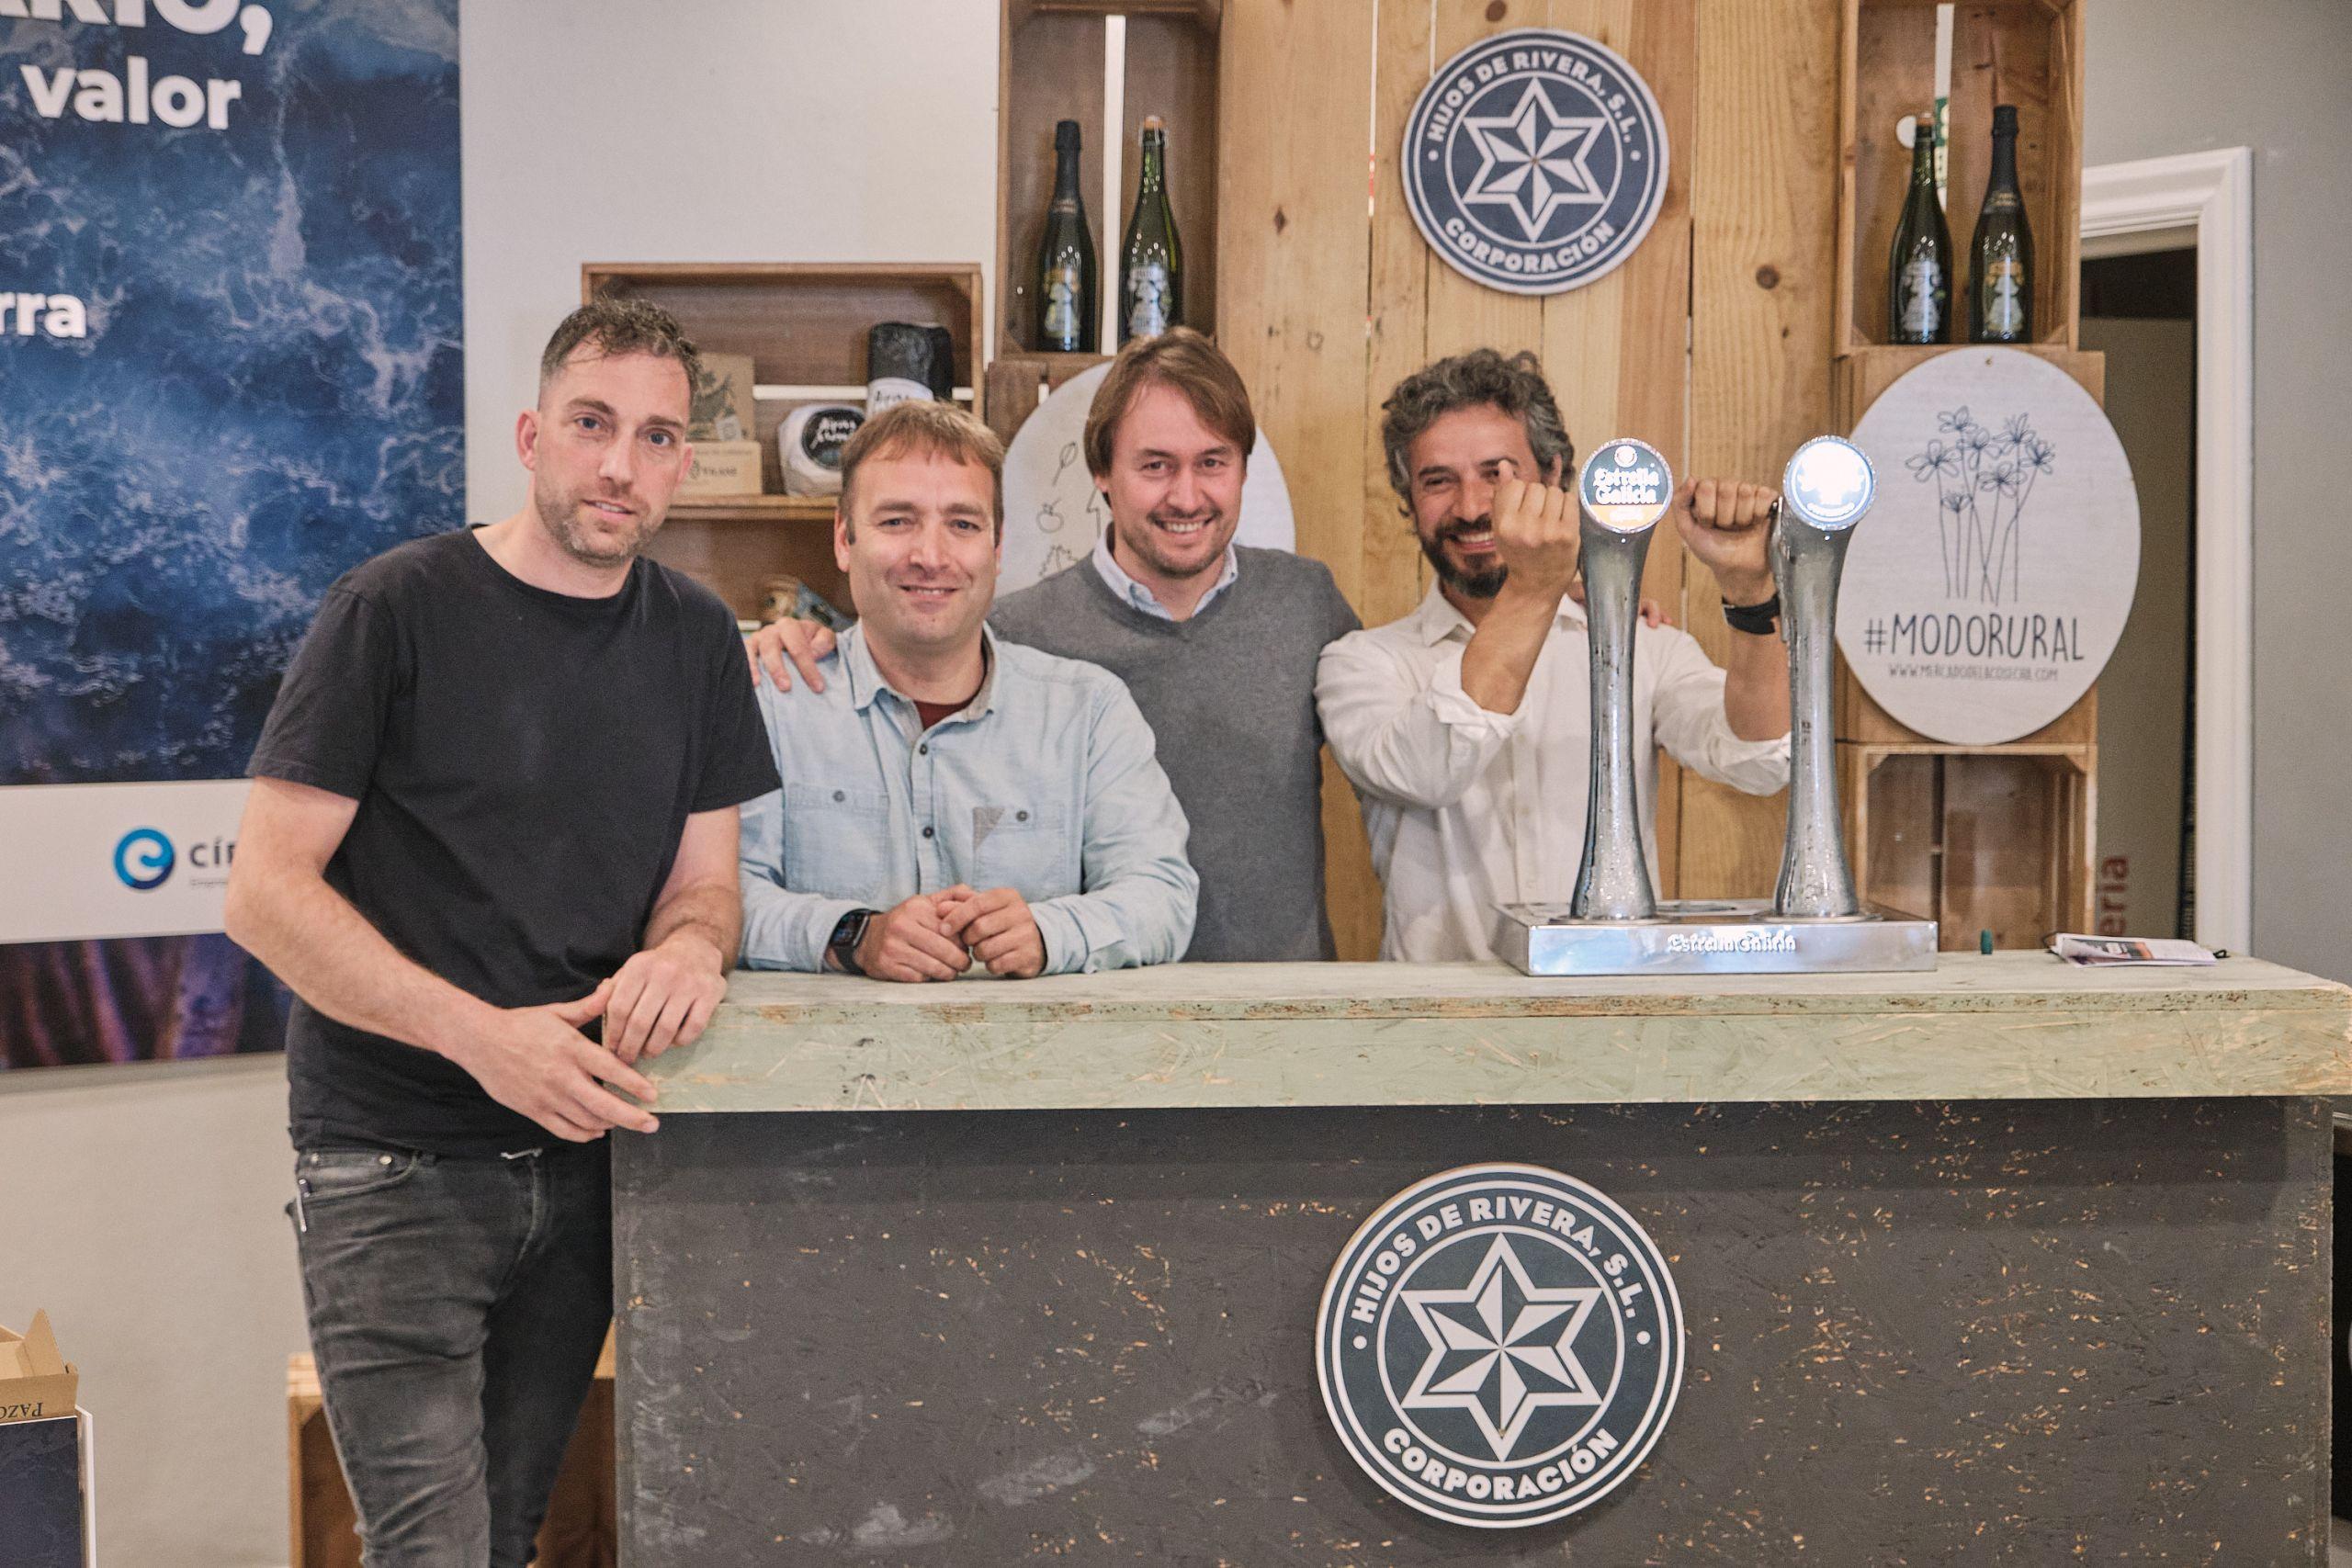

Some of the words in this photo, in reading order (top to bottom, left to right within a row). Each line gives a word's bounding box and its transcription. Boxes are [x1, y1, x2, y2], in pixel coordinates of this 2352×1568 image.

[20, 55, 242, 130] valor
[1427, 76, 1476, 142] HIJOS
[1476, 55, 1509, 84] DE
[1512, 50, 1607, 97] RIVERA,
[1607, 93, 1638, 143] S.L.
[1444, 217, 1615, 273] CORPORACIÓN
[1864, 613, 2085, 661] #MODORURAL
[1350, 1231, 1418, 1324] HIJOS
[1416, 1203, 1464, 1242] DE
[1469, 1196, 1602, 1258] RIVERA,
[1603, 1253, 1646, 1319] S.L.
[1383, 1427, 1619, 1500] CORPORACIÓN
